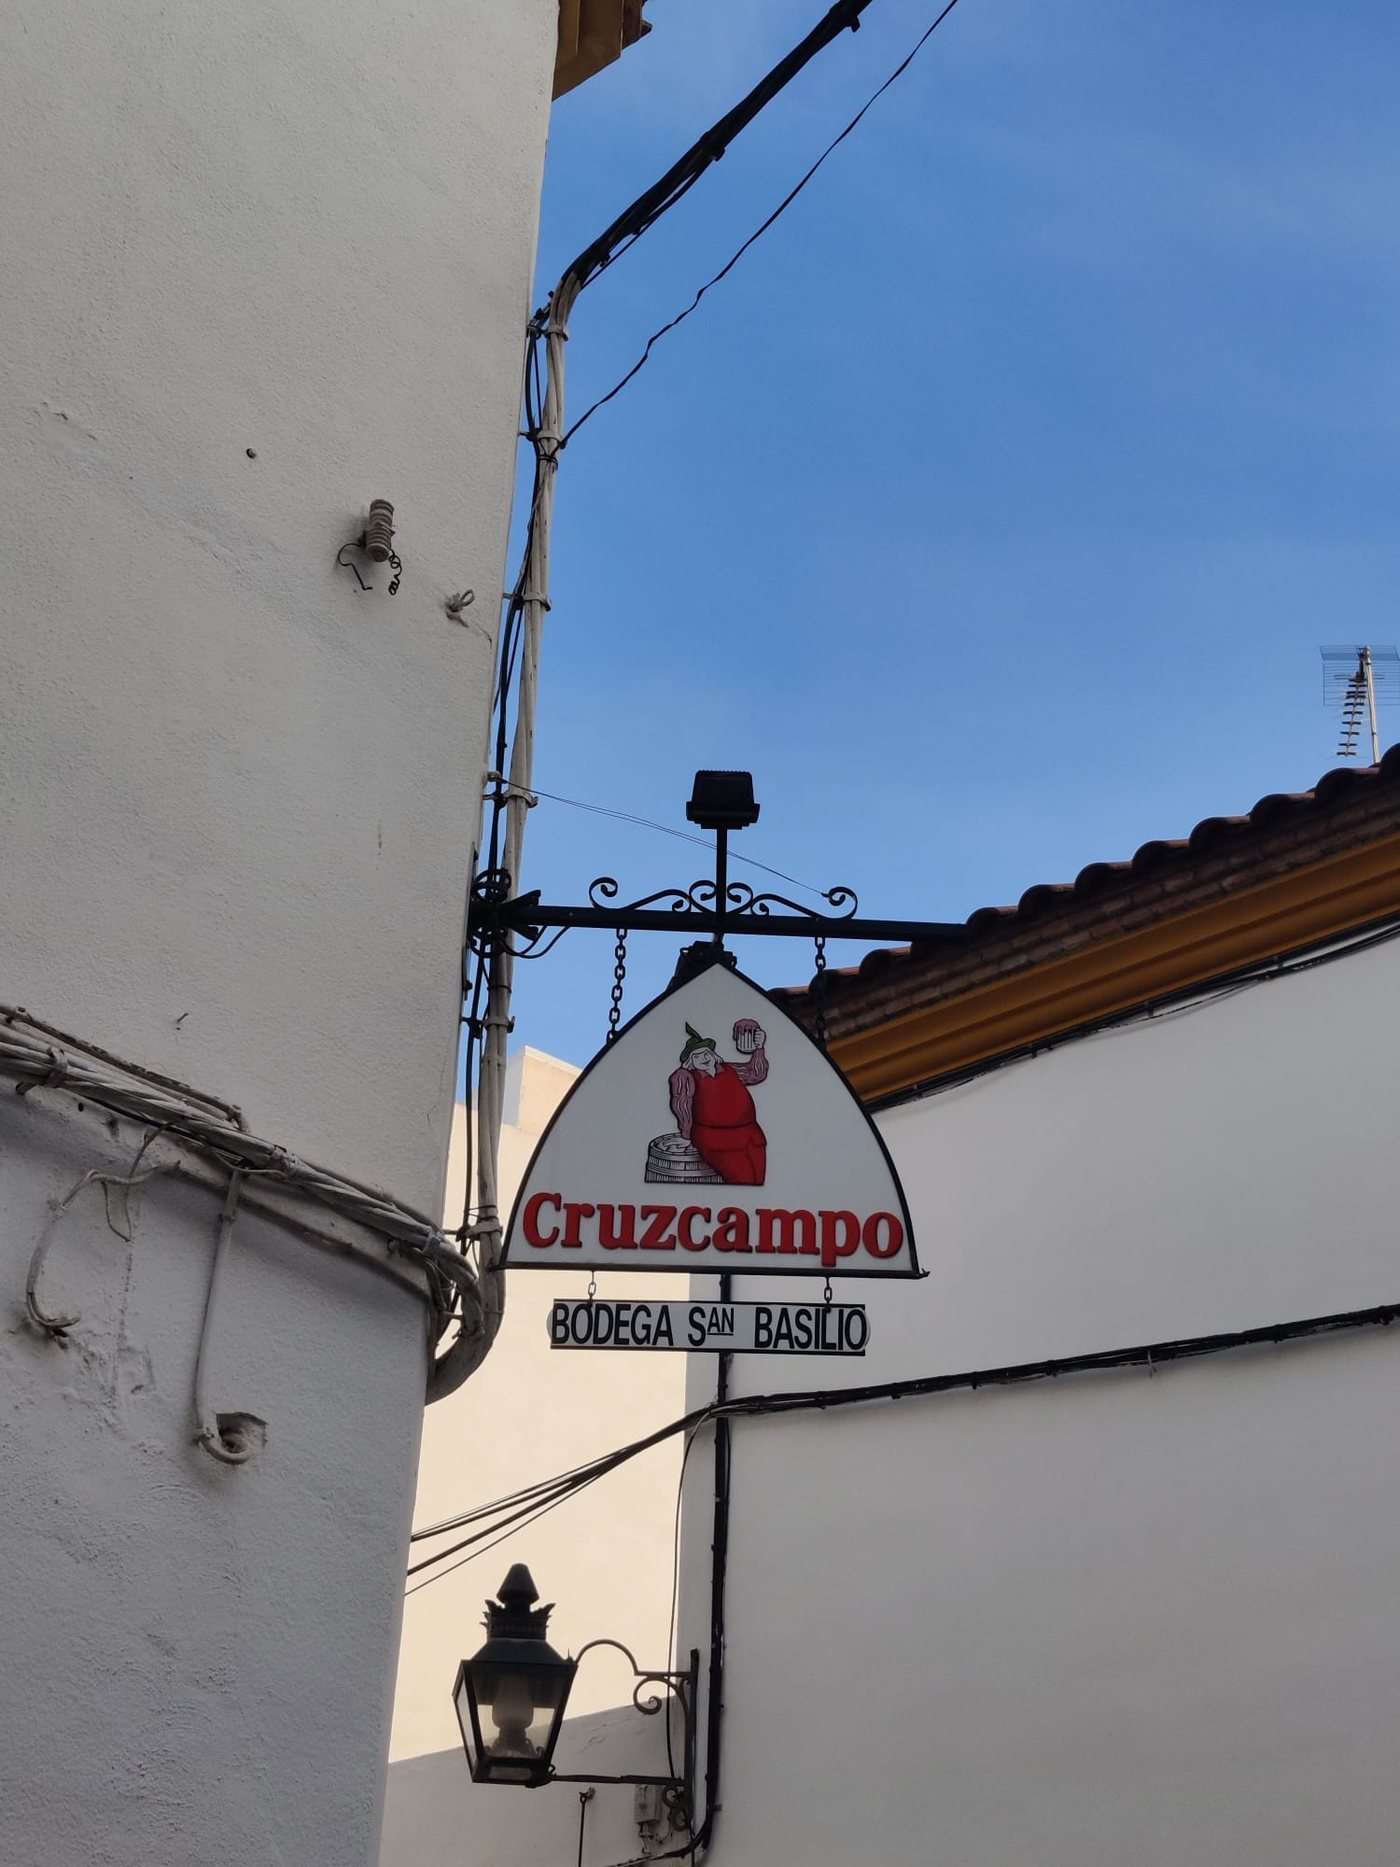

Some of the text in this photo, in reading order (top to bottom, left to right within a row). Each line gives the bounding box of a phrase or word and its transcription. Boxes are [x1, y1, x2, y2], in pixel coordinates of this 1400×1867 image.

[522, 1192, 904, 1267] Cruzcampo
[551, 1303, 867, 1350] BODEGA SAN BASILIO
